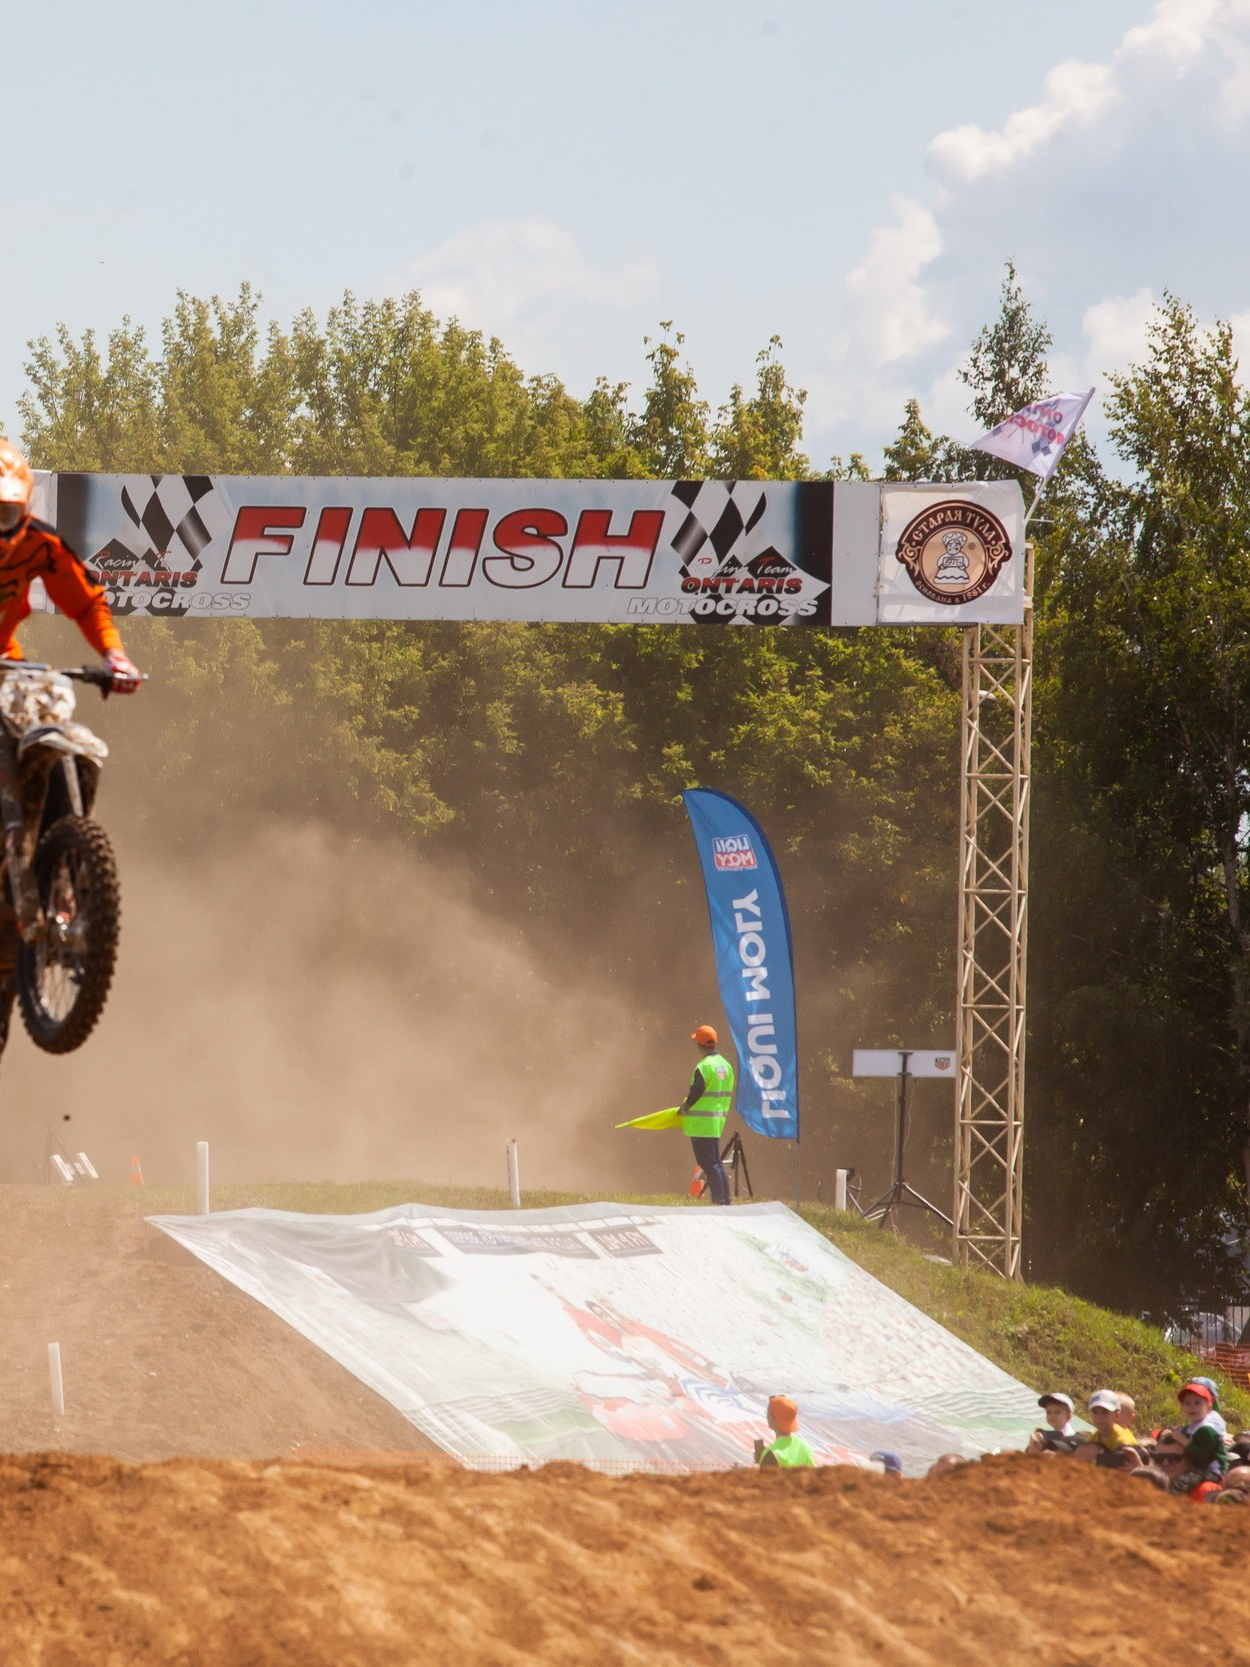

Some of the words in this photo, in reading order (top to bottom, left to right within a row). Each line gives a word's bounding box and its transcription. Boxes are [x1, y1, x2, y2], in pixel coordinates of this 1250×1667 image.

[912, 509, 962, 541] СТАРАЯ
[966, 512, 996, 542] ТУЛА
[220, 505, 666, 589] FINISH
[681, 577, 803, 596] ONTARIS
[105, 591, 251, 610] OTOCROSS
[626, 597, 819, 617] MOTOCROSS
